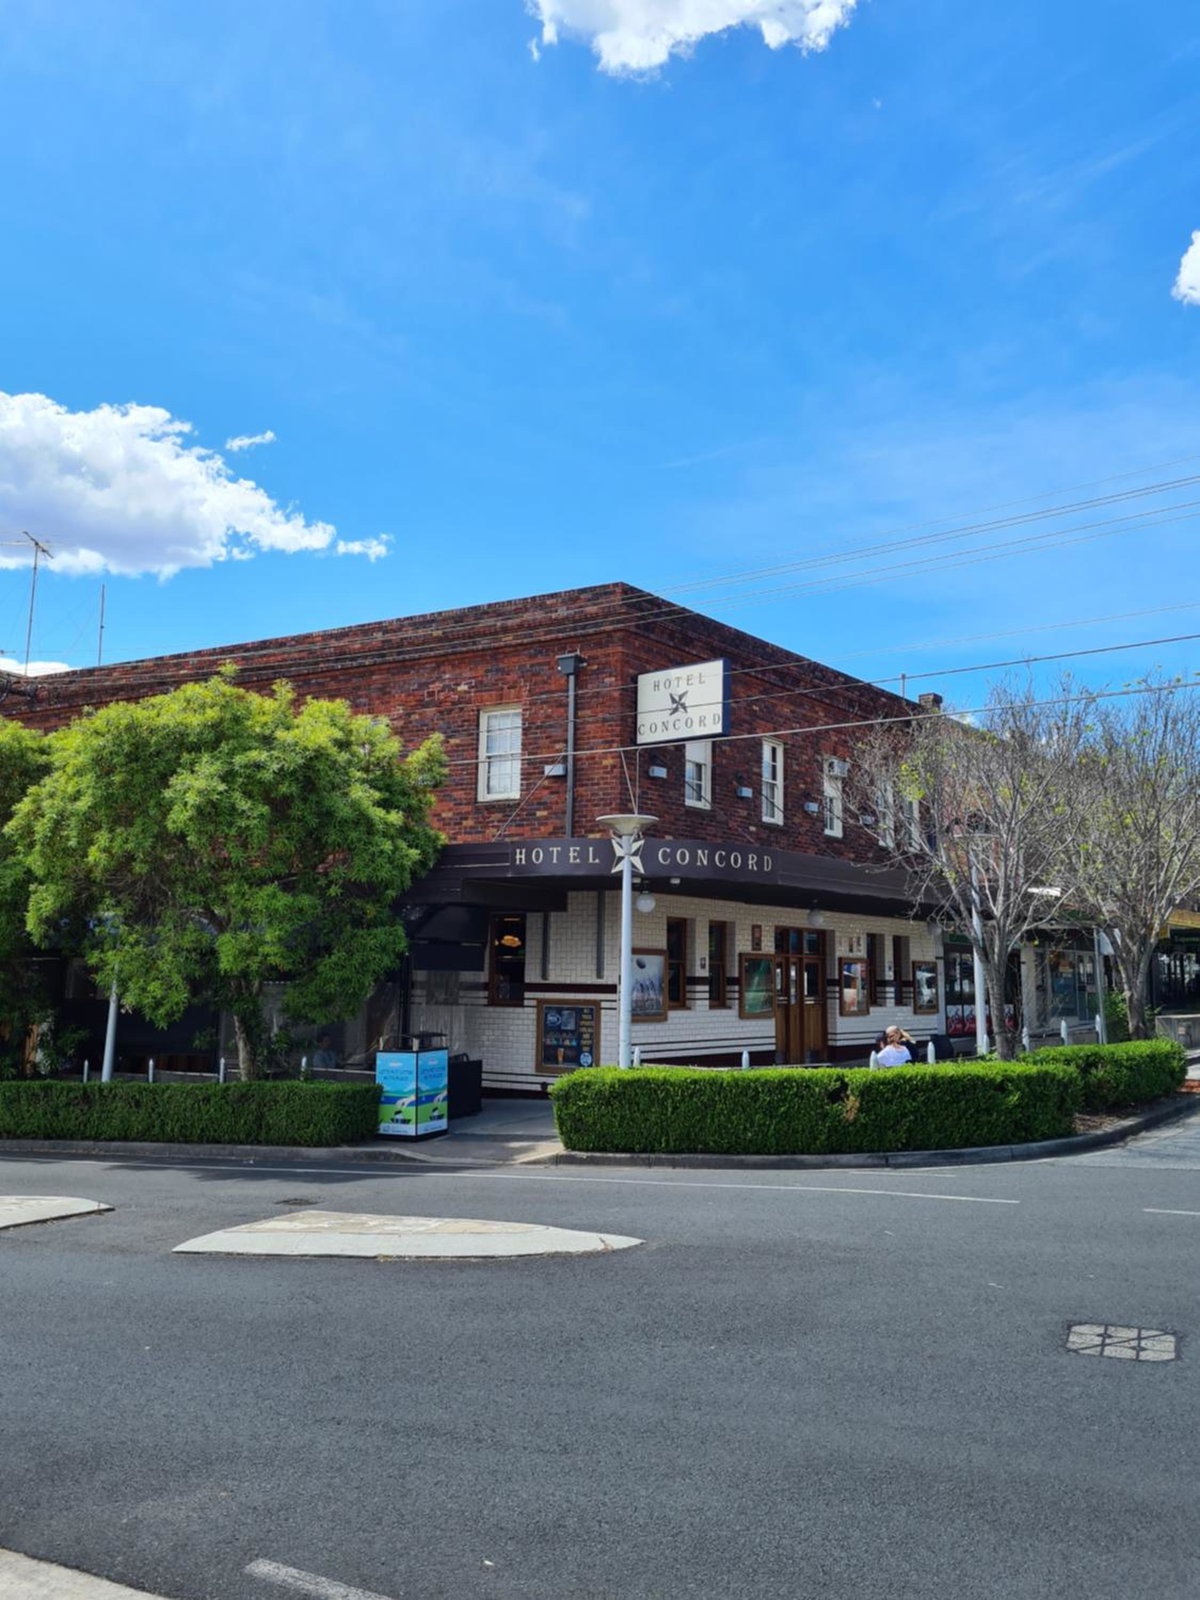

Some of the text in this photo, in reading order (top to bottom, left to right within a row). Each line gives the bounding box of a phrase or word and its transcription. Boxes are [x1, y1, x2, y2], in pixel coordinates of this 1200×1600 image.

[653, 672, 706, 692] HOTEL
[637, 713, 721, 736] CONCORD
[515, 847, 772, 871] HOTEL CONCORD
